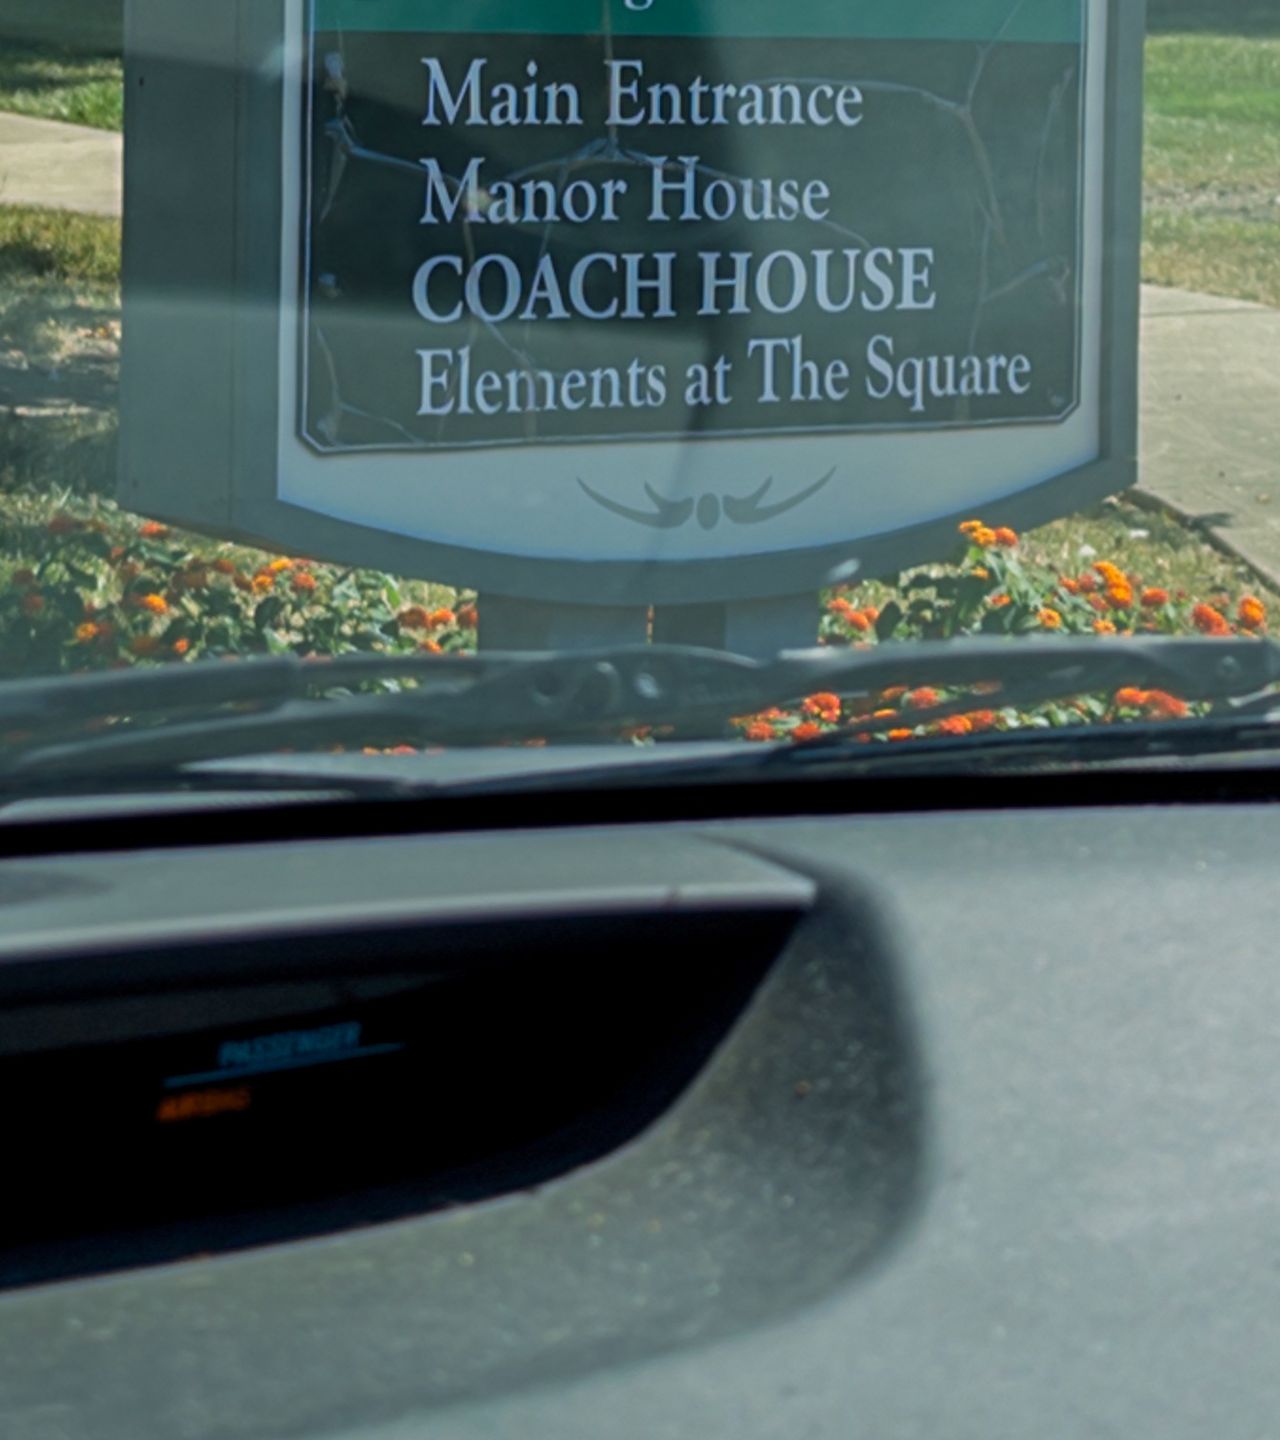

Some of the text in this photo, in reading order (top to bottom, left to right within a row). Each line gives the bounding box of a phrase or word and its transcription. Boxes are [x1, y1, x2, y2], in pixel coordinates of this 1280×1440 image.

[420, 58, 864, 127] Main Entrance
[419, 156, 830, 225] Manor House
[412, 248, 936, 323] COACH HOUSE
[416, 334, 1031, 417] Elements at The Square
